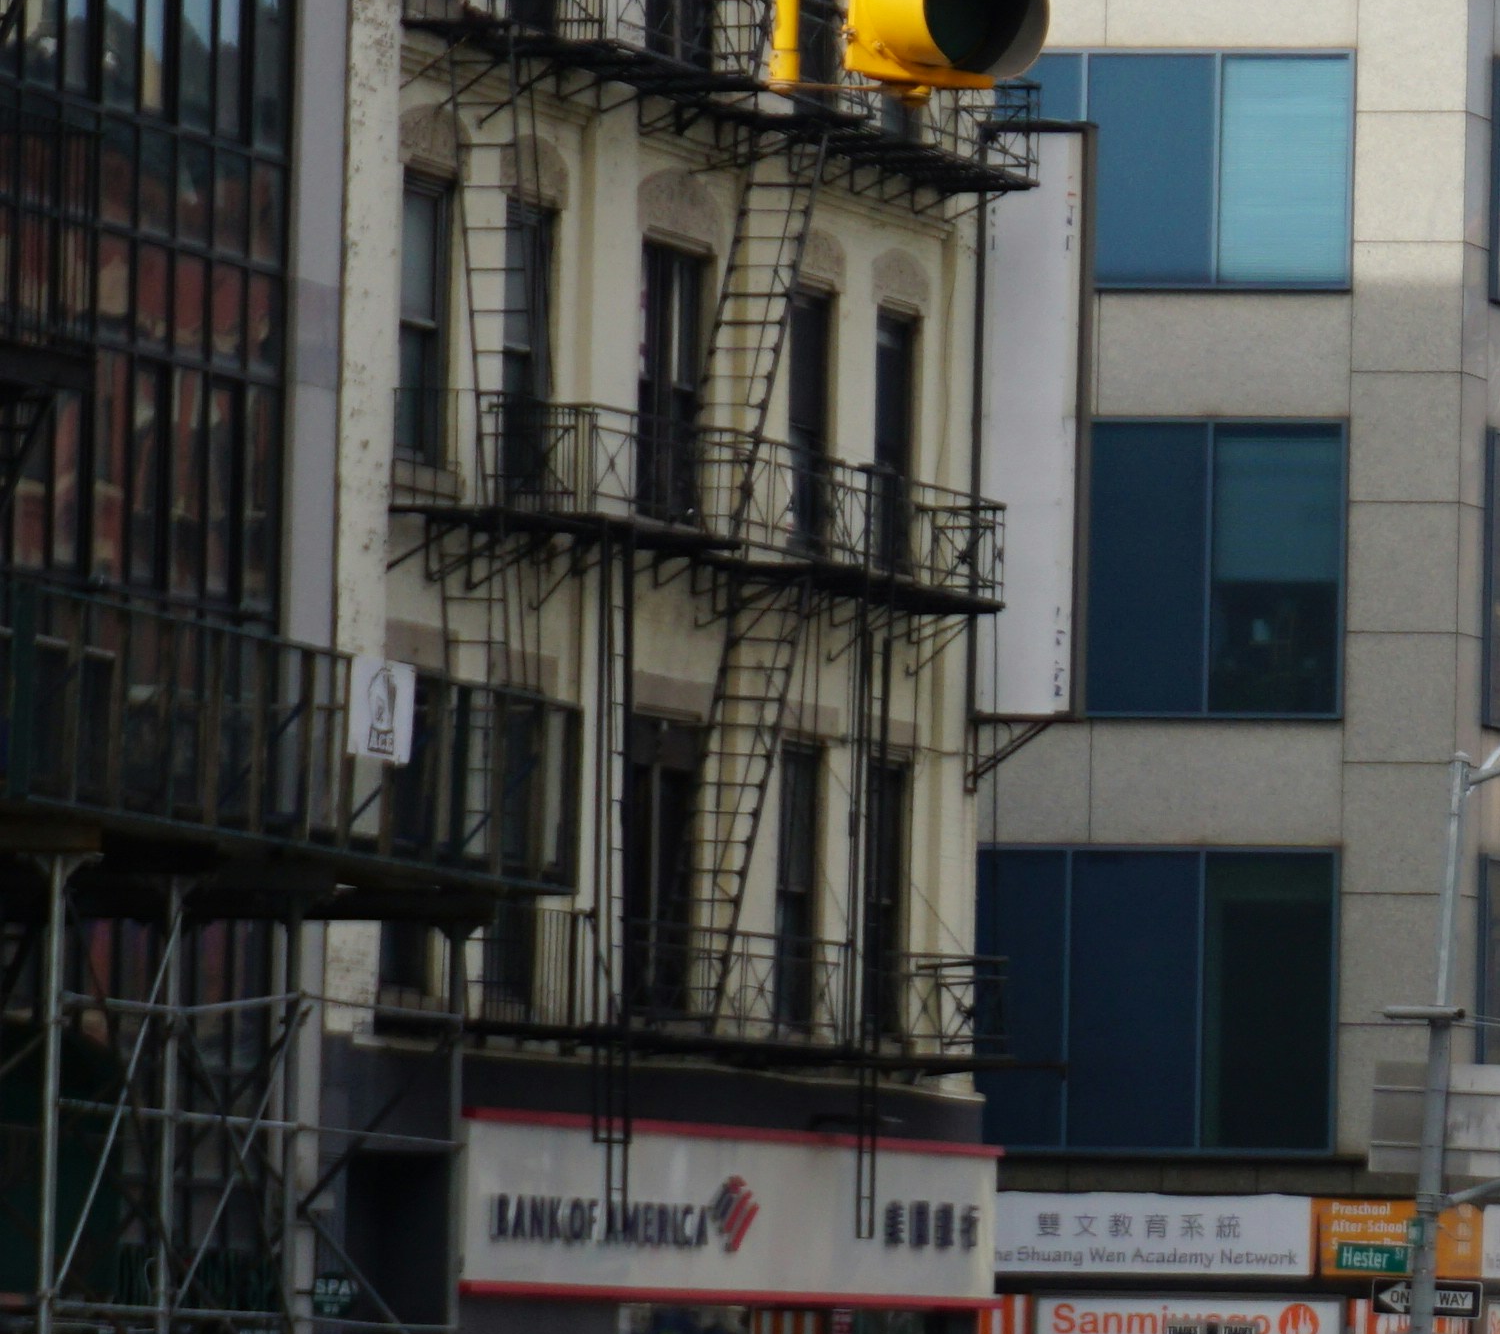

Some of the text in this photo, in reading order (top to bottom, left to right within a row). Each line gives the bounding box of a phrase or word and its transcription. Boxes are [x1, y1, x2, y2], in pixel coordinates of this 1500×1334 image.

[1332, 1201, 1391, 1216] Preschool
[490, 1193, 710, 1249] BANK OF AMERICA
[1036, 1212, 1242, 1239] 雙文教育系統
[1331, 1220, 1362, 1233] After
[1016, 1246, 1084, 1266] Shuang
[1089, 1247, 1126, 1264] Wen
[1130, 1246, 1216, 1268] Academy
[1220, 1247, 1299, 1266] Network
[1342, 1247, 1391, 1268] Hester
[1390, 1290, 1469, 1306] ON WAY
